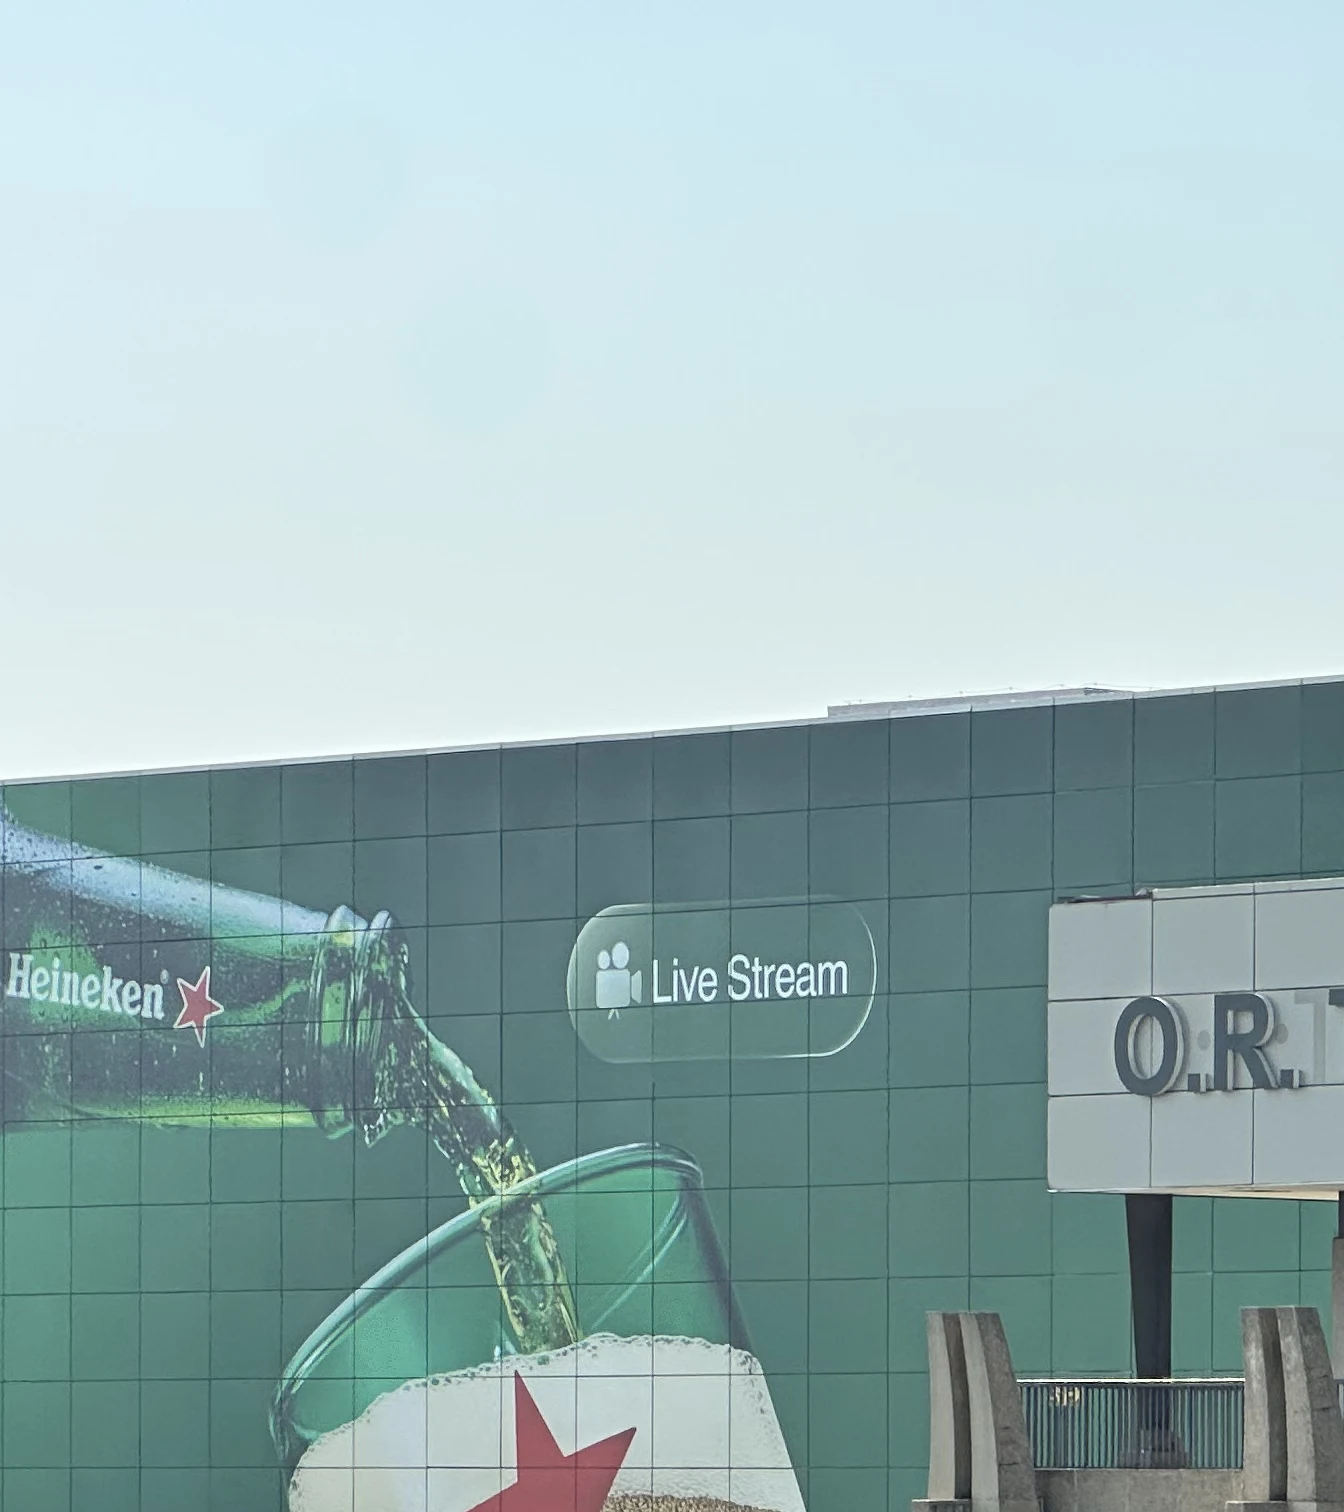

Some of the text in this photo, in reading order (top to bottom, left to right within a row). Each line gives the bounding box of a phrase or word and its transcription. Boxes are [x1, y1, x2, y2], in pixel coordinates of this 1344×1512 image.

[6, 952, 165, 1020] Heineken
[653, 953, 848, 1003] Live Stream
[1114, 990, 1300, 1096] O.R.
